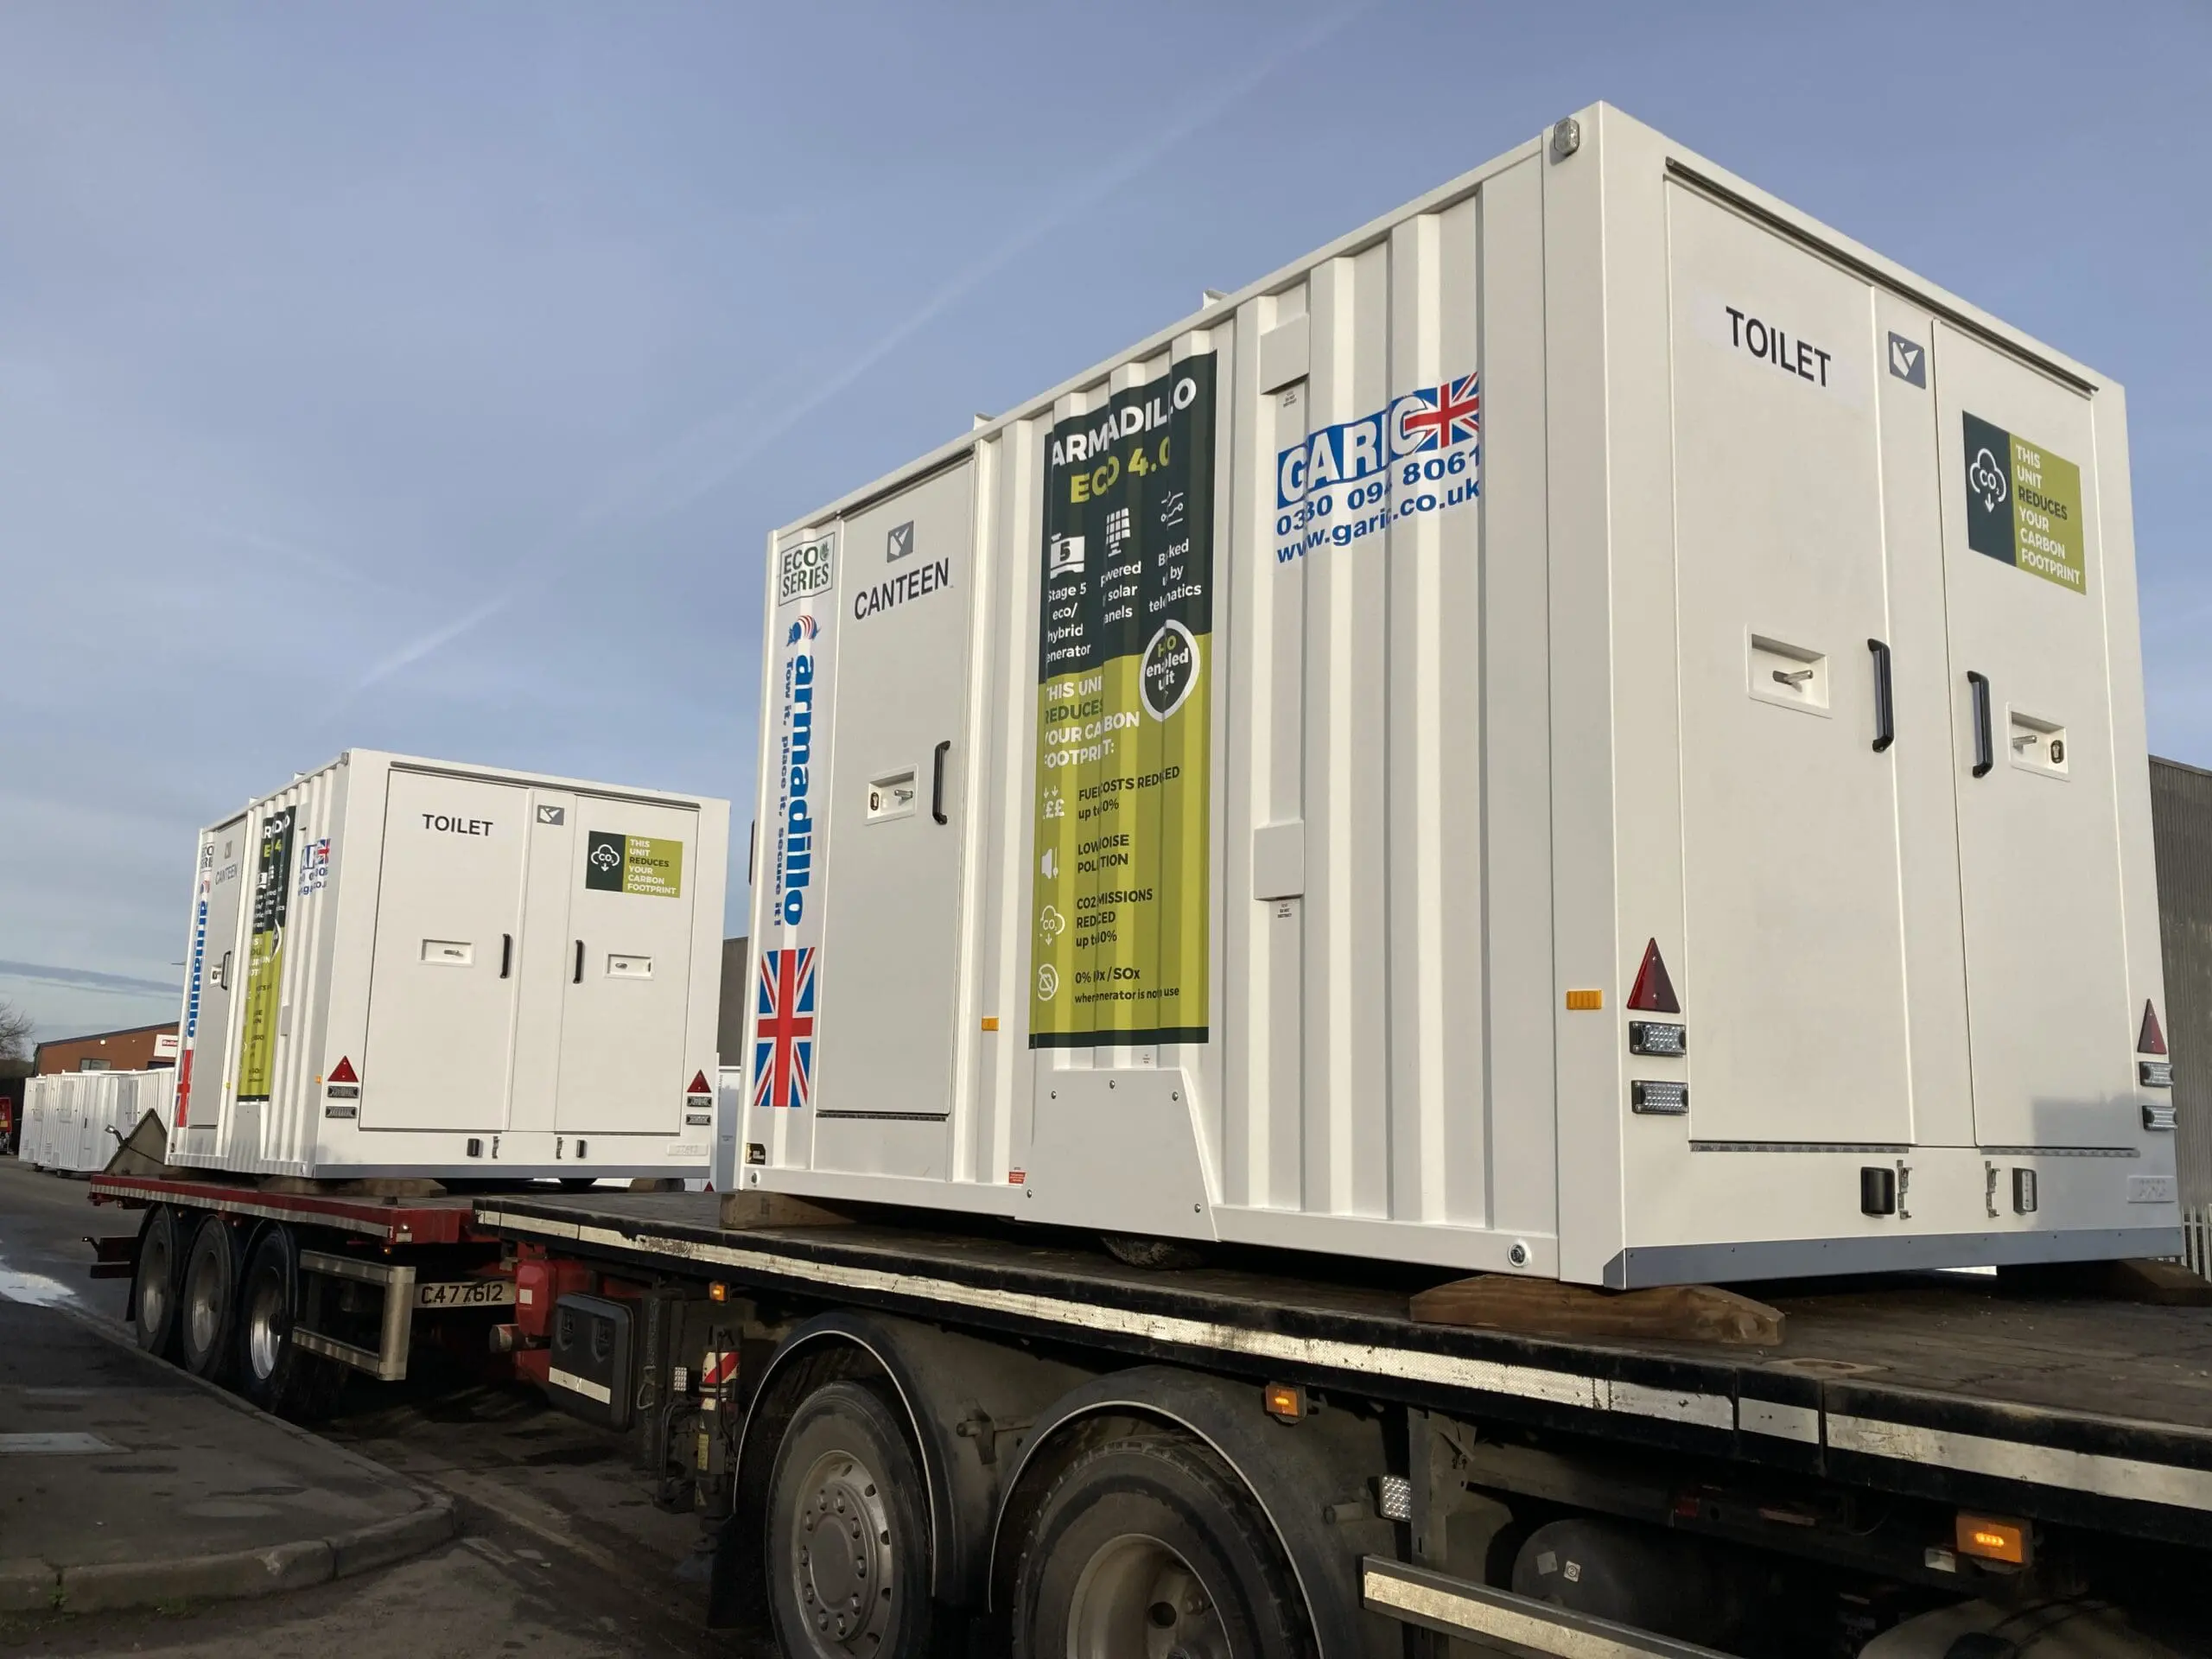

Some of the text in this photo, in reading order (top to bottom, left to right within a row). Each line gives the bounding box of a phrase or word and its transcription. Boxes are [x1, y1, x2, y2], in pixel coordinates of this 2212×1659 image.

[1726, 306, 1831, 387] TOILET
[1052, 378, 1197, 467] ARMADILO
[2015, 443, 2041, 469] THIS
[1071, 455, 1120, 503] ECO
[2017, 465, 2043, 490] UNIT
[2018, 486, 2068, 520] REDUCES
[2019, 506, 2050, 533] YOUR
[1059, 541, 1071, 562] 5
[2020, 528, 2065, 560] CARBON
[784, 546, 819, 575] ECO
[2021, 548, 2081, 585] FOOTPRINT
[782, 563, 830, 597] SERIES
[1170, 565, 1184, 580] by
[854, 557, 950, 620] CANTEEN
[1079, 582, 1087, 595] 5
[1108, 584, 1138, 601] solar
[1052, 602, 1078, 620] eco/
[1103, 605, 1133, 623] anels
[1046, 644, 1091, 663] enerator
[785, 657, 794, 699] Tow
[1078, 676, 1103, 696] UNI
[1084, 711, 1141, 740] CABON
[780, 735, 789, 790] place
[784, 654, 815, 925] armadillo
[422, 813, 493, 837] TOILET
[1078, 810, 1090, 821] up
[629, 839, 651, 848] THIS
[629, 848, 651, 856] UNIT
[629, 856, 670, 868] REDUCES
[629, 865, 653, 874] YOUR
[774, 827, 785, 896] secure
[627, 883, 677, 894] FOOTPRINT
[628, 874, 664, 885] CARBON
[1097, 888, 1154, 906] MISSIONS
[1076, 937, 1089, 949] up
[1075, 971, 1091, 984] 0%
[1113, 967, 1141, 980] SOx
[1138, 988, 1145, 1000] is
[1164, 987, 1179, 997] use
[422, 1284, 504, 1304] C477612
